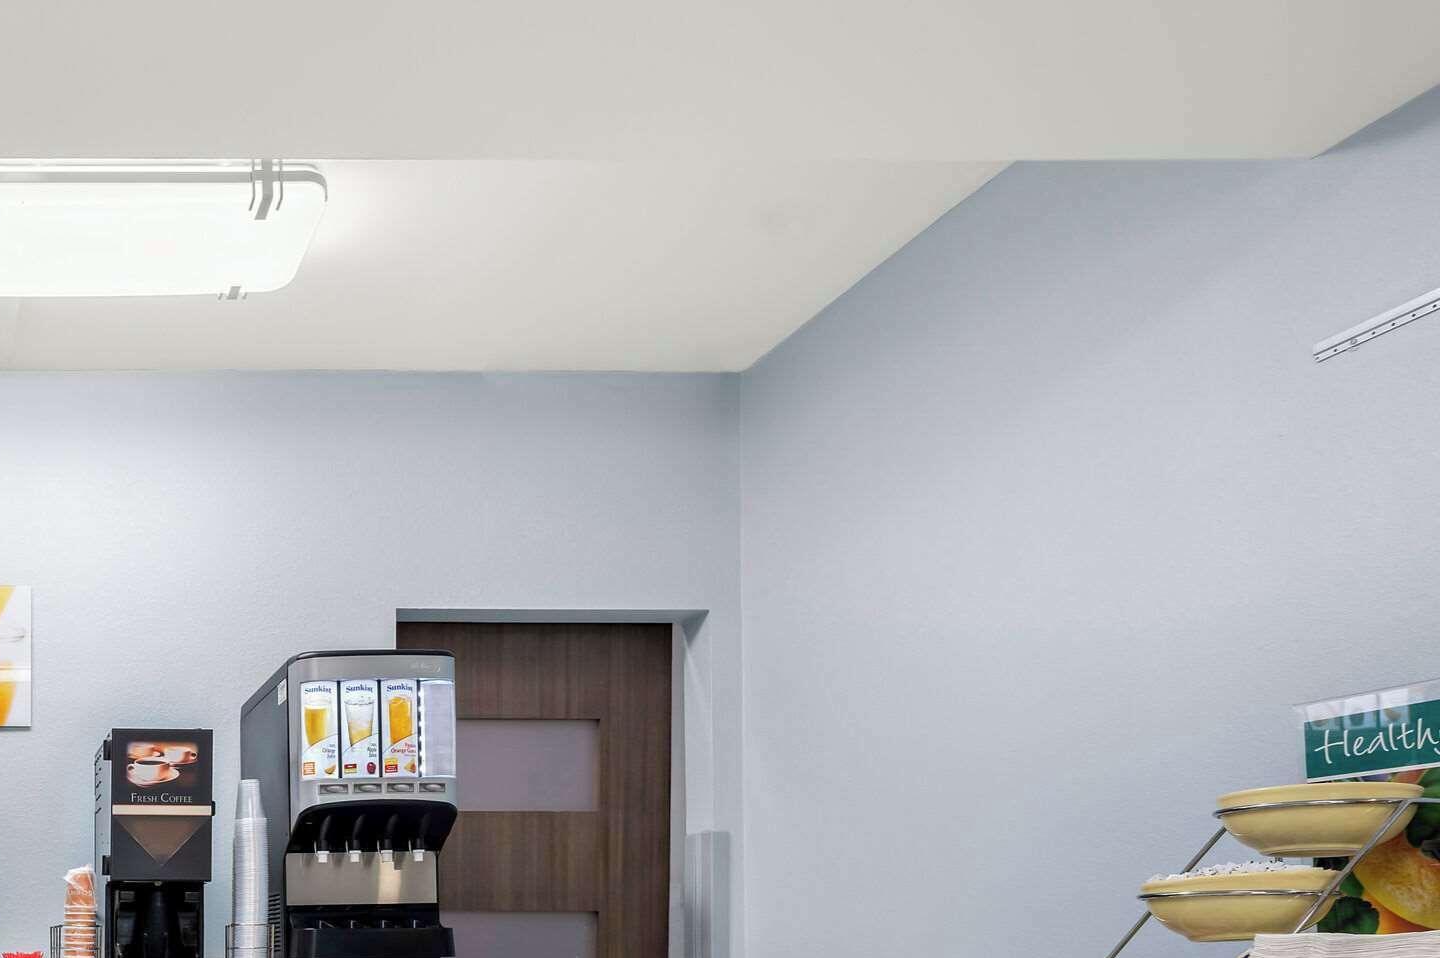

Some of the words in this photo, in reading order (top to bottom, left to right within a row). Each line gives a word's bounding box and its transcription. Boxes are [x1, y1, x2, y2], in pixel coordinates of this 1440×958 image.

[1314, 718, 1440, 764] Health
[131, 793, 158, 803] FRESH
[160, 793, 193, 803] COFFEE
